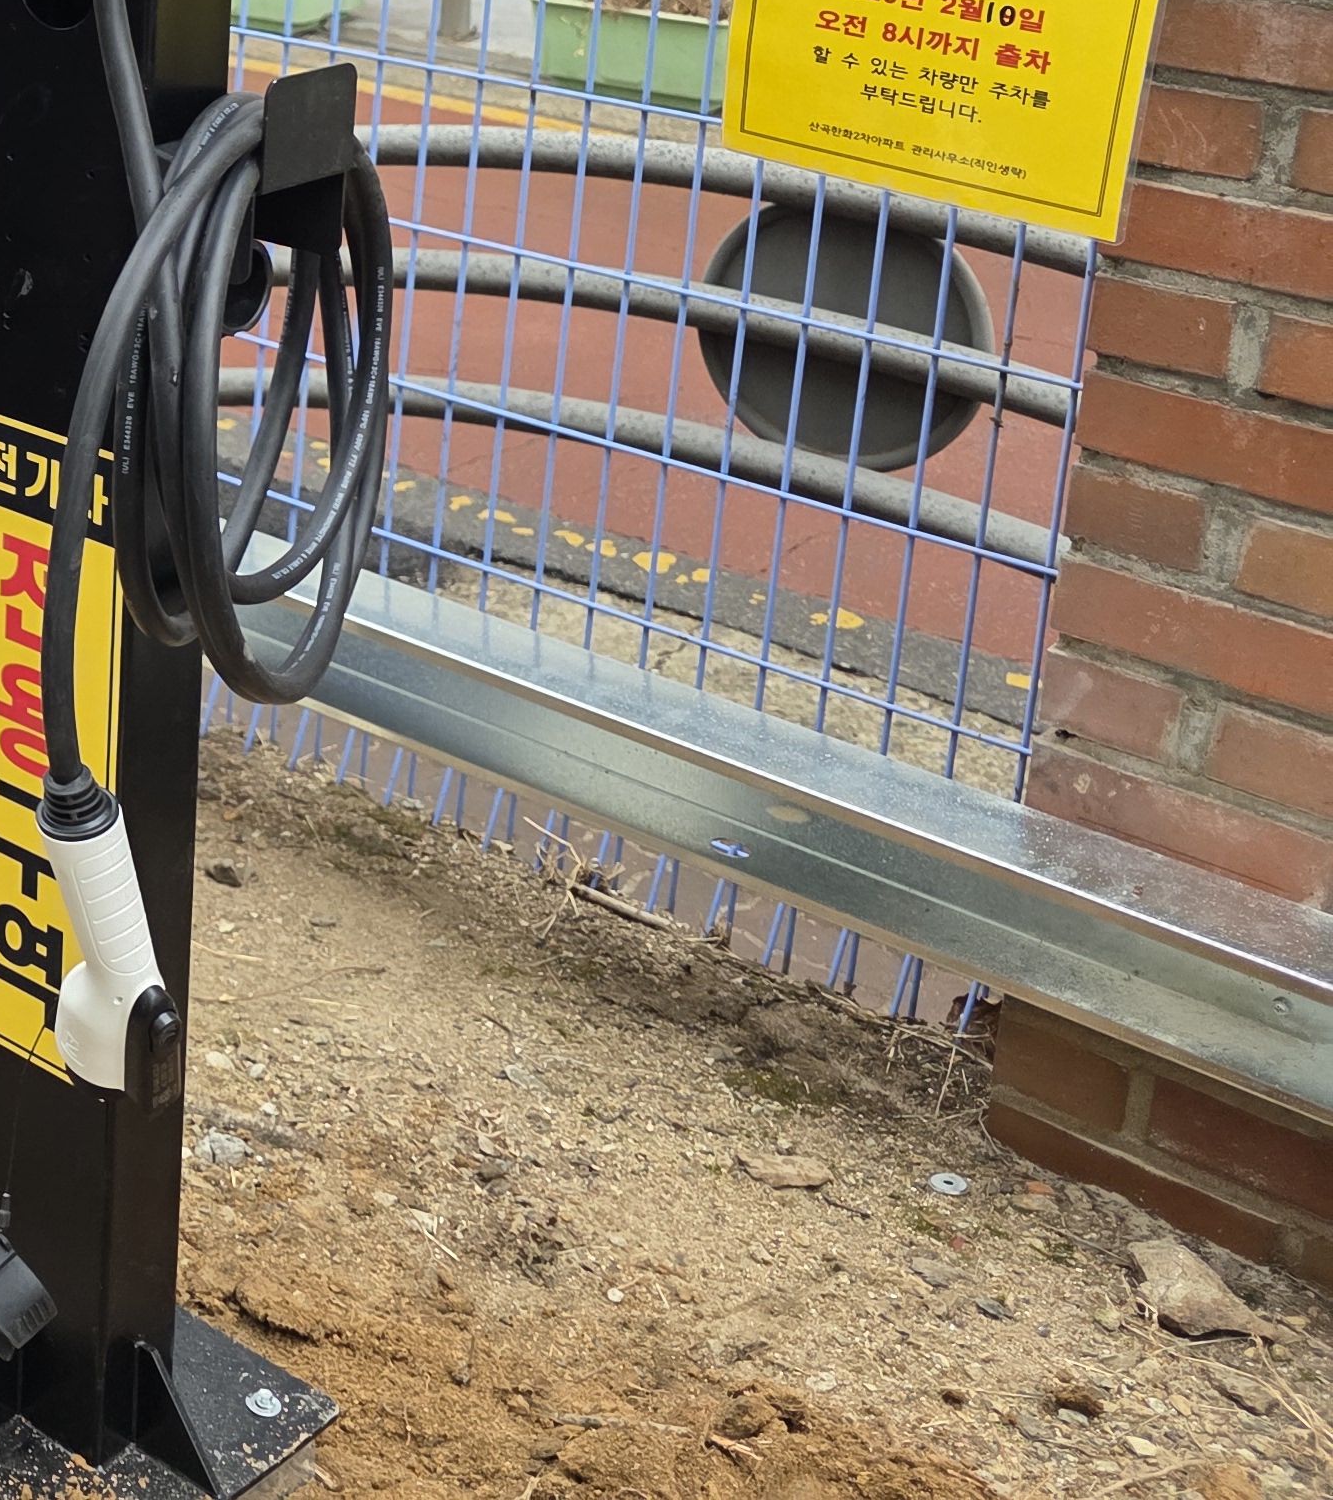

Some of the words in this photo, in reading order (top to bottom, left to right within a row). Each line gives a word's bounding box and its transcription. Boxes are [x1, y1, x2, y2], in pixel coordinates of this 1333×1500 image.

[815, 9, 868, 39] 오전
[881, 22, 980, 61] 8시까지
[994, 42, 1051, 75] 출차
[812, 45, 832, 64] 할
[841, 52, 860, 69] 수
[870, 57, 909, 81] 있는
[918, 66, 979, 95] 차량만
[989, 82, 1051, 110] 주차를
[860, 83, 982, 124] 부탁드립니다.
[809, 121, 906, 151] 산곡한화2차아파트
[127, 391, 135, 409] EVE
